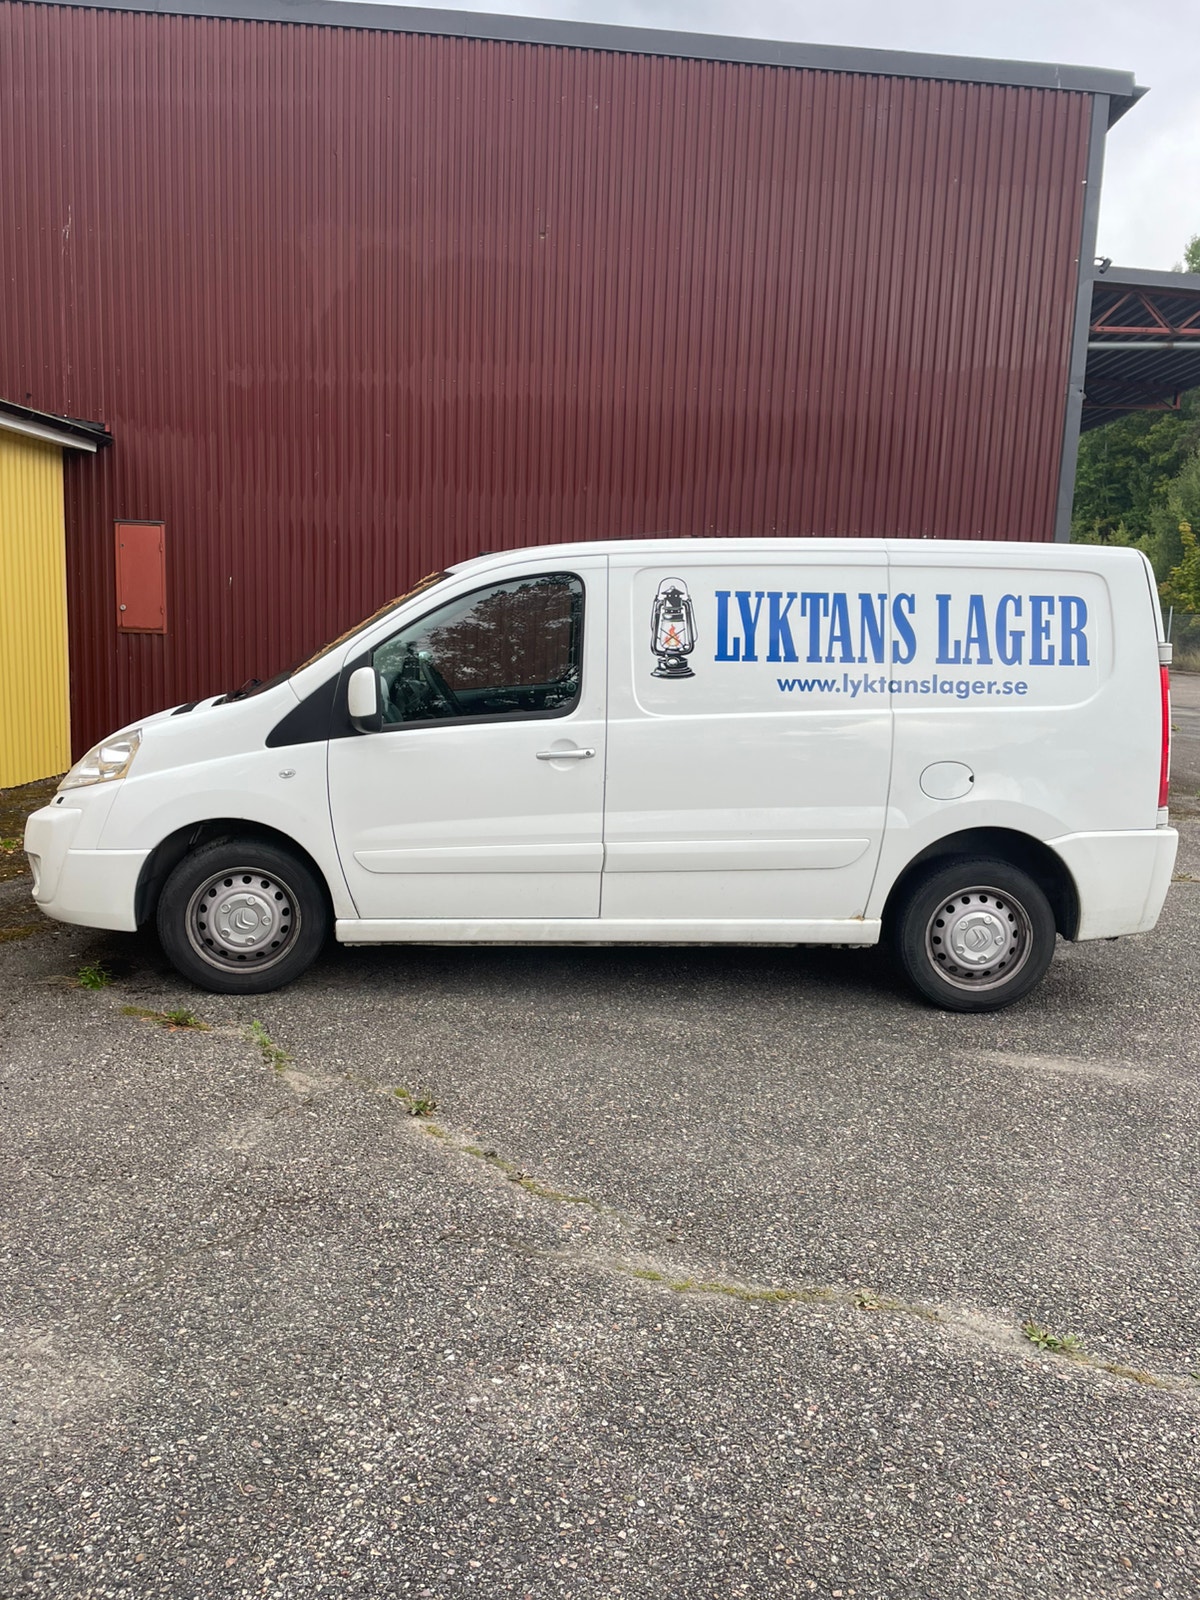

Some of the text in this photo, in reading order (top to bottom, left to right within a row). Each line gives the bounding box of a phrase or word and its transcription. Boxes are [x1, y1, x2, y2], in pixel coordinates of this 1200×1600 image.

[714, 591, 1090, 666] LYKTANS LAGER
[776, 673, 1028, 699] www.lyktanslager.se
